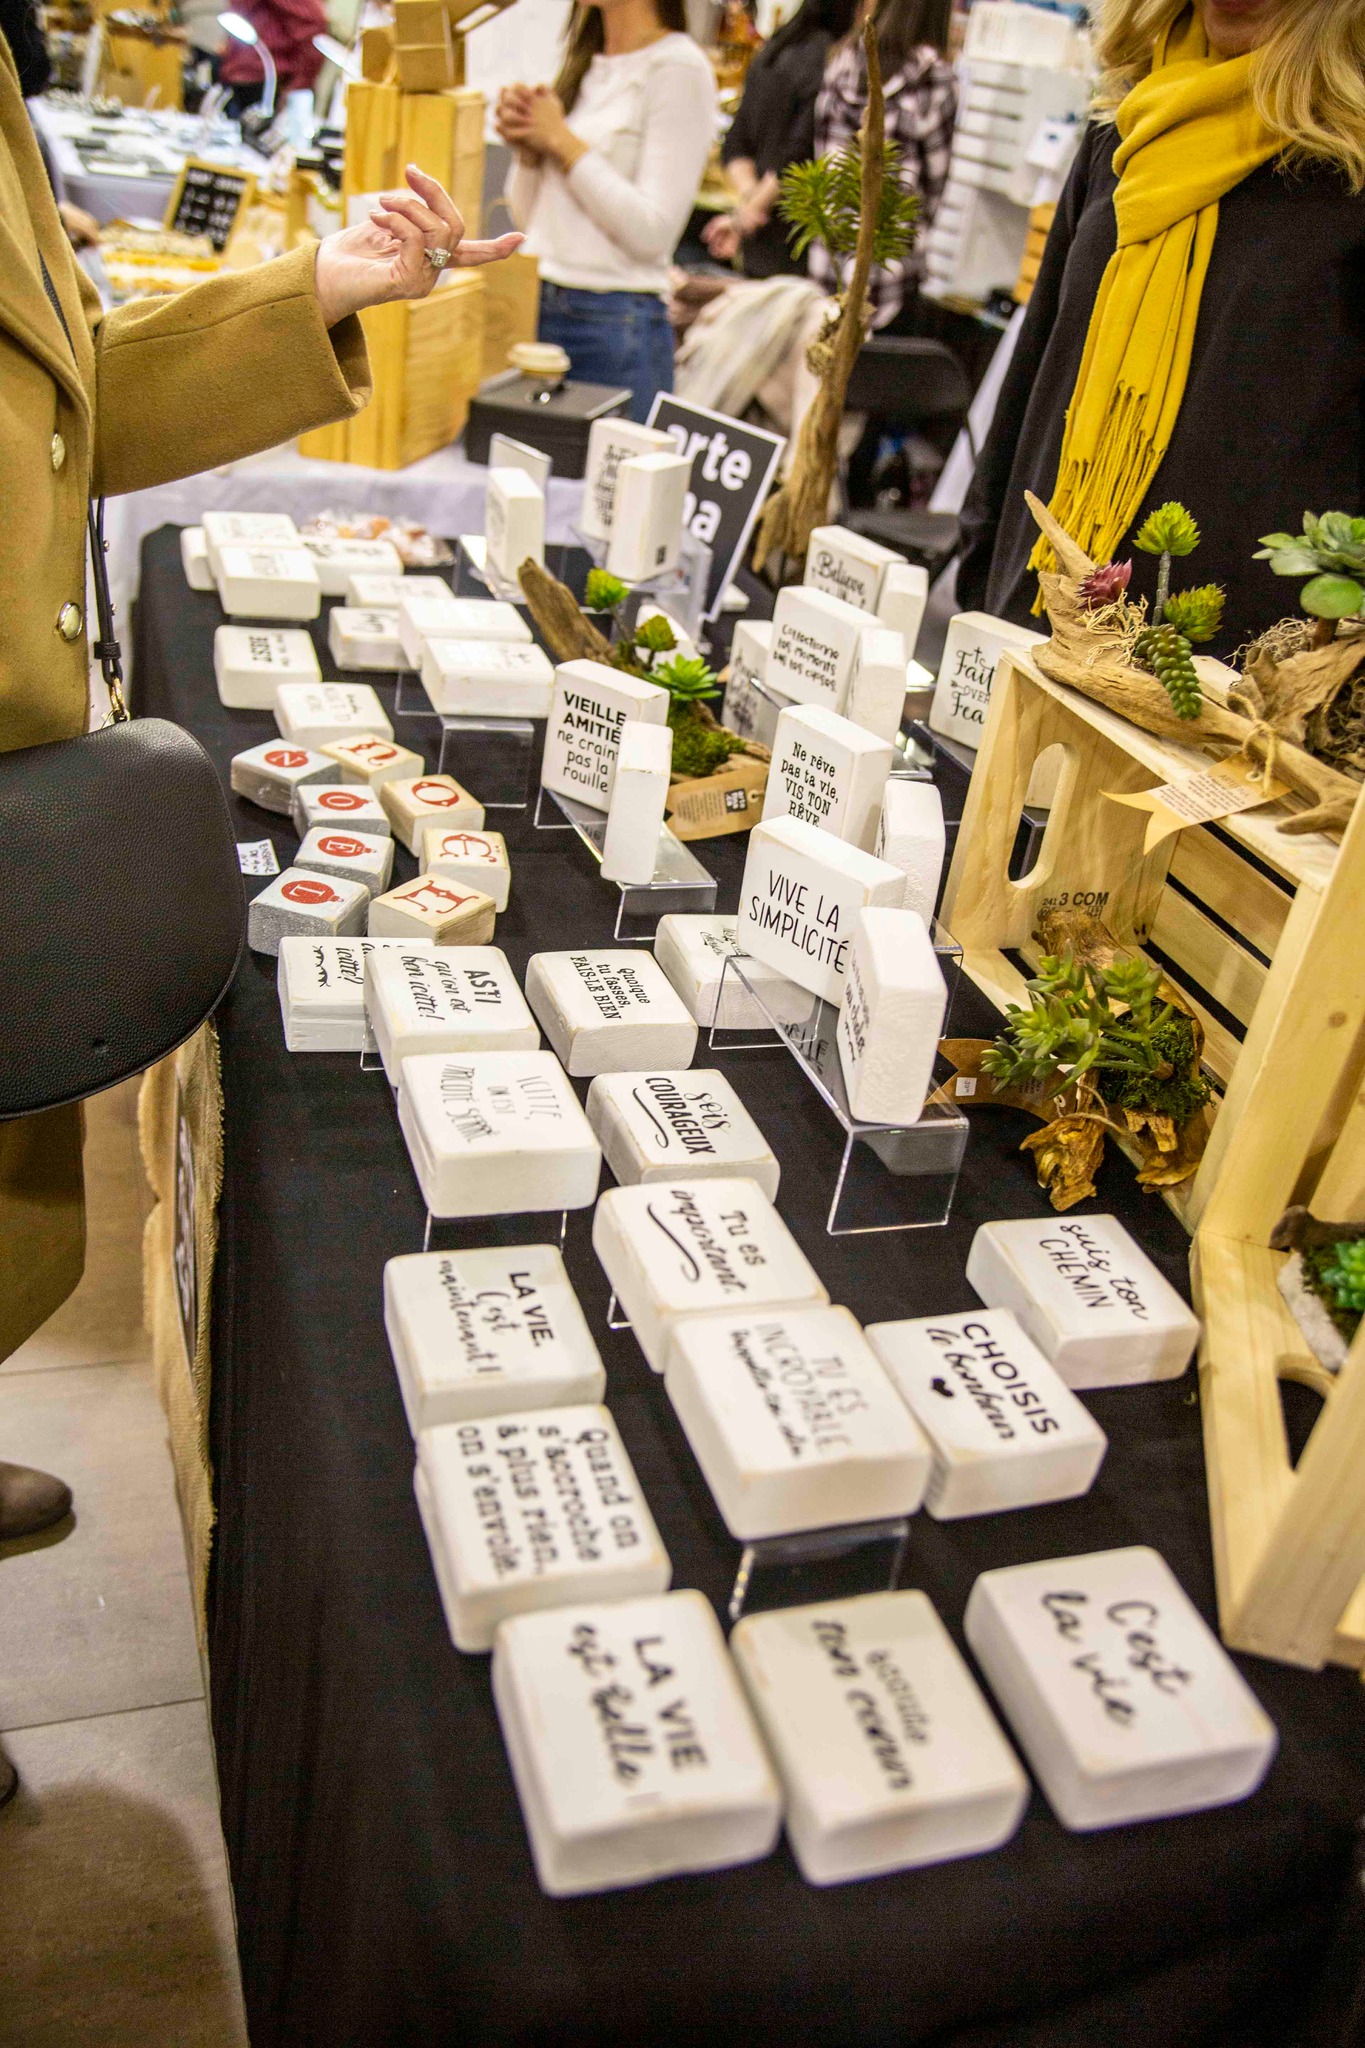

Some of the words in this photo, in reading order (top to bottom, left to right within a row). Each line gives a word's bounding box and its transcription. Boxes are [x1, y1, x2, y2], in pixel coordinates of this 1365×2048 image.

[667, 423, 752, 491] arte
[954, 649, 997, 693] Fait
[563, 690, 627, 726] VIEILLE
[563, 711, 622, 745] AMITIÉ
[951, 691, 985, 725] Fea
[557, 728, 574, 746] ne
[563, 766, 609, 794] rouille
[566, 750, 591, 771] pas
[595, 757, 609, 776] la
[780, 758, 802, 782] pas
[804, 770, 817, 787] ta
[819, 779, 840, 804] vie,
[792, 741, 806, 763] Ne
[809, 753, 837, 779] rêve
[412, 781, 460, 807] O
[785, 777, 804, 800] VIS
[807, 789, 833, 817] TON
[788, 797, 821, 828] RÊVE
[769, 869, 809, 915] VIVE
[816, 895, 840, 933] LA
[1072, 891, 1110, 906] COM
[749, 895, 850, 975] SIMPLICITÉ
[463, 969, 502, 1005] ASTI
[570, 956, 604, 993] FAIS-LE
[593, 992, 622, 1021] BIEN
[596, 963, 609, 975] tu
[603, 976, 631, 1010] fasses,
[619, 966, 651, 1005] Quoique
[645, 1077, 717, 1155] COURAGEUX
[684, 1091, 731, 1134] sois
[719, 1209, 749, 1237] Tu
[738, 1243, 767, 1268] es
[508, 1271, 537, 1300] LA
[1039, 1238, 1114, 1310] CHEMIN
[1060, 1224, 1111, 1273] suis
[1109, 1276, 1149, 1320] ton
[944, 1351, 1016, 1441] bonheur
[963, 1323, 1060, 1435] CHOISIS
[457, 1425, 486, 1457] on
[496, 1446, 541, 1499] plus
[575, 1428, 631, 1507] Quand
[609, 1514, 640, 1549] on
[1041, 1589, 1089, 1644] la
[1072, 1651, 1136, 1730] vie
[634, 1635, 675, 1687] LA
[658, 1699, 709, 1770] VIE
[591, 1683, 655, 1787] belle
